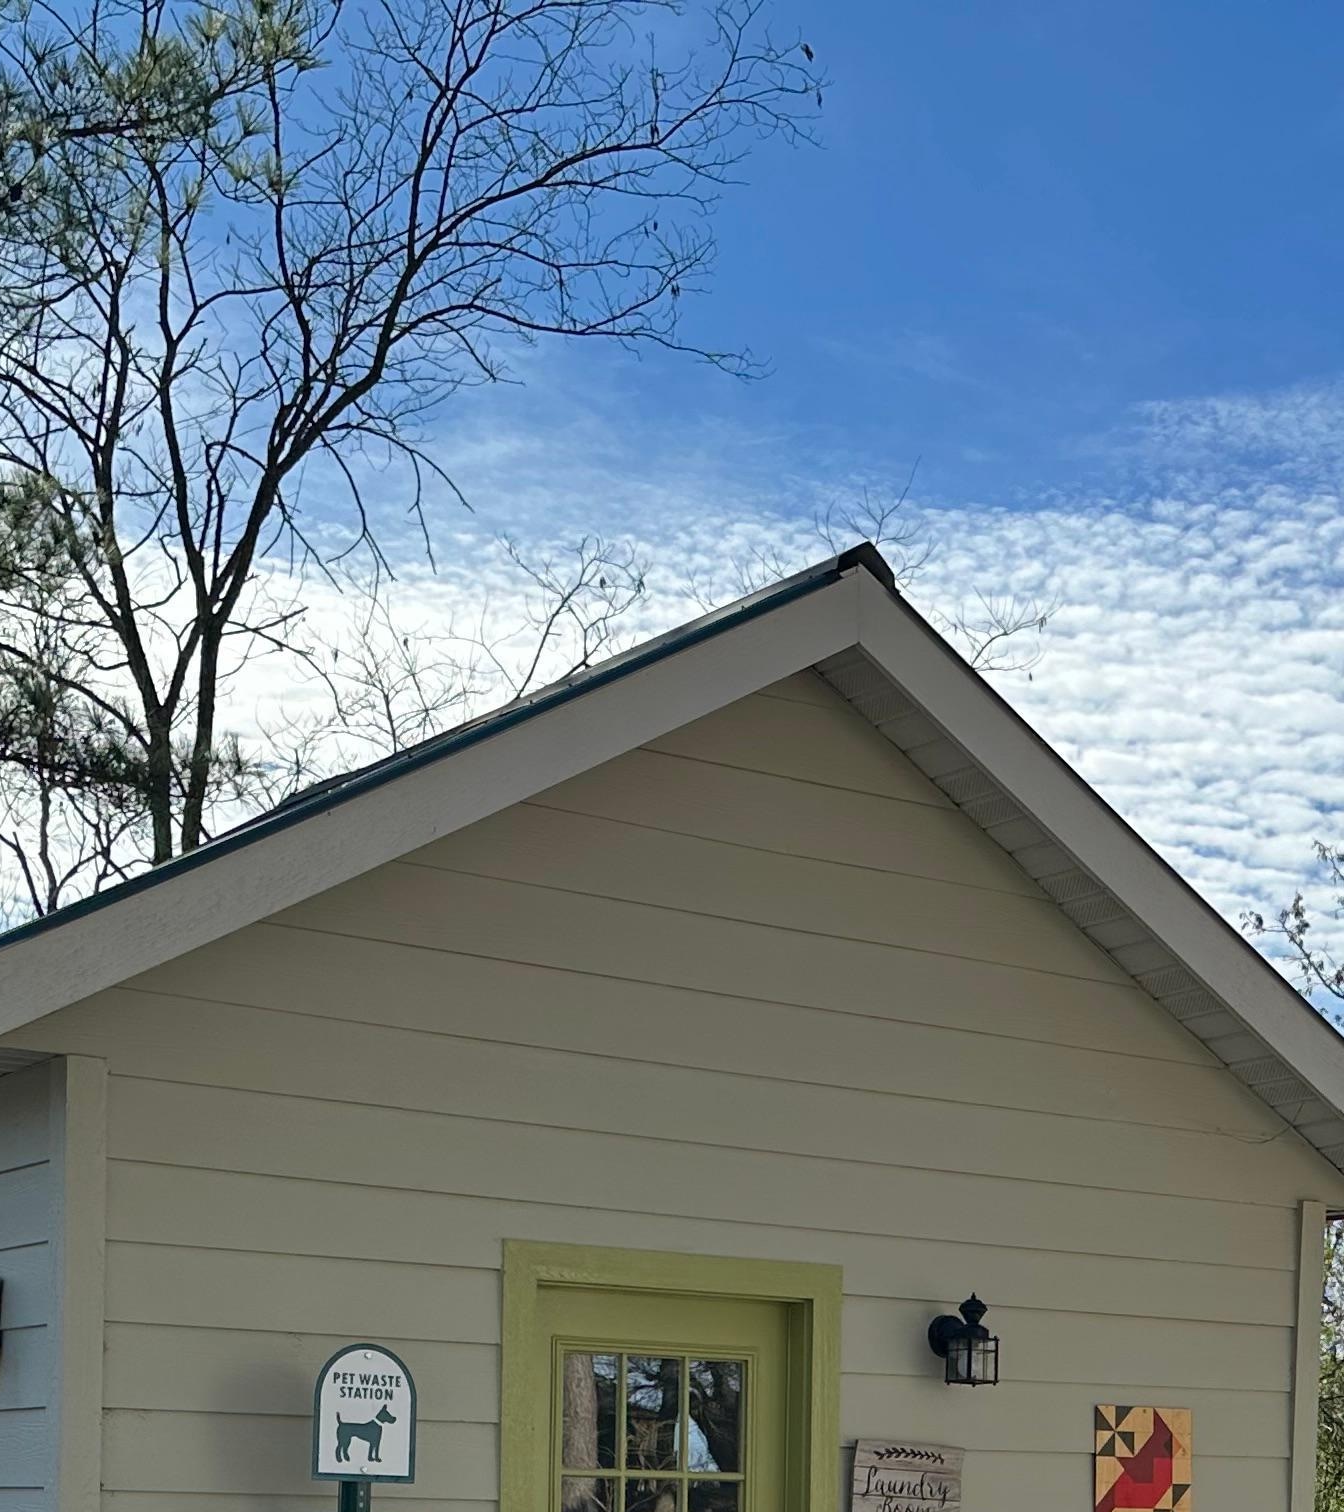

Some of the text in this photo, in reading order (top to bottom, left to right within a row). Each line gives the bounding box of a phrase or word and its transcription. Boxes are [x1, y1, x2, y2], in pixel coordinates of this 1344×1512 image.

[333, 1372, 401, 1388] PET WASTE
[339, 1386, 394, 1401] STATION
[862, 1465, 951, 1508] Laundry
